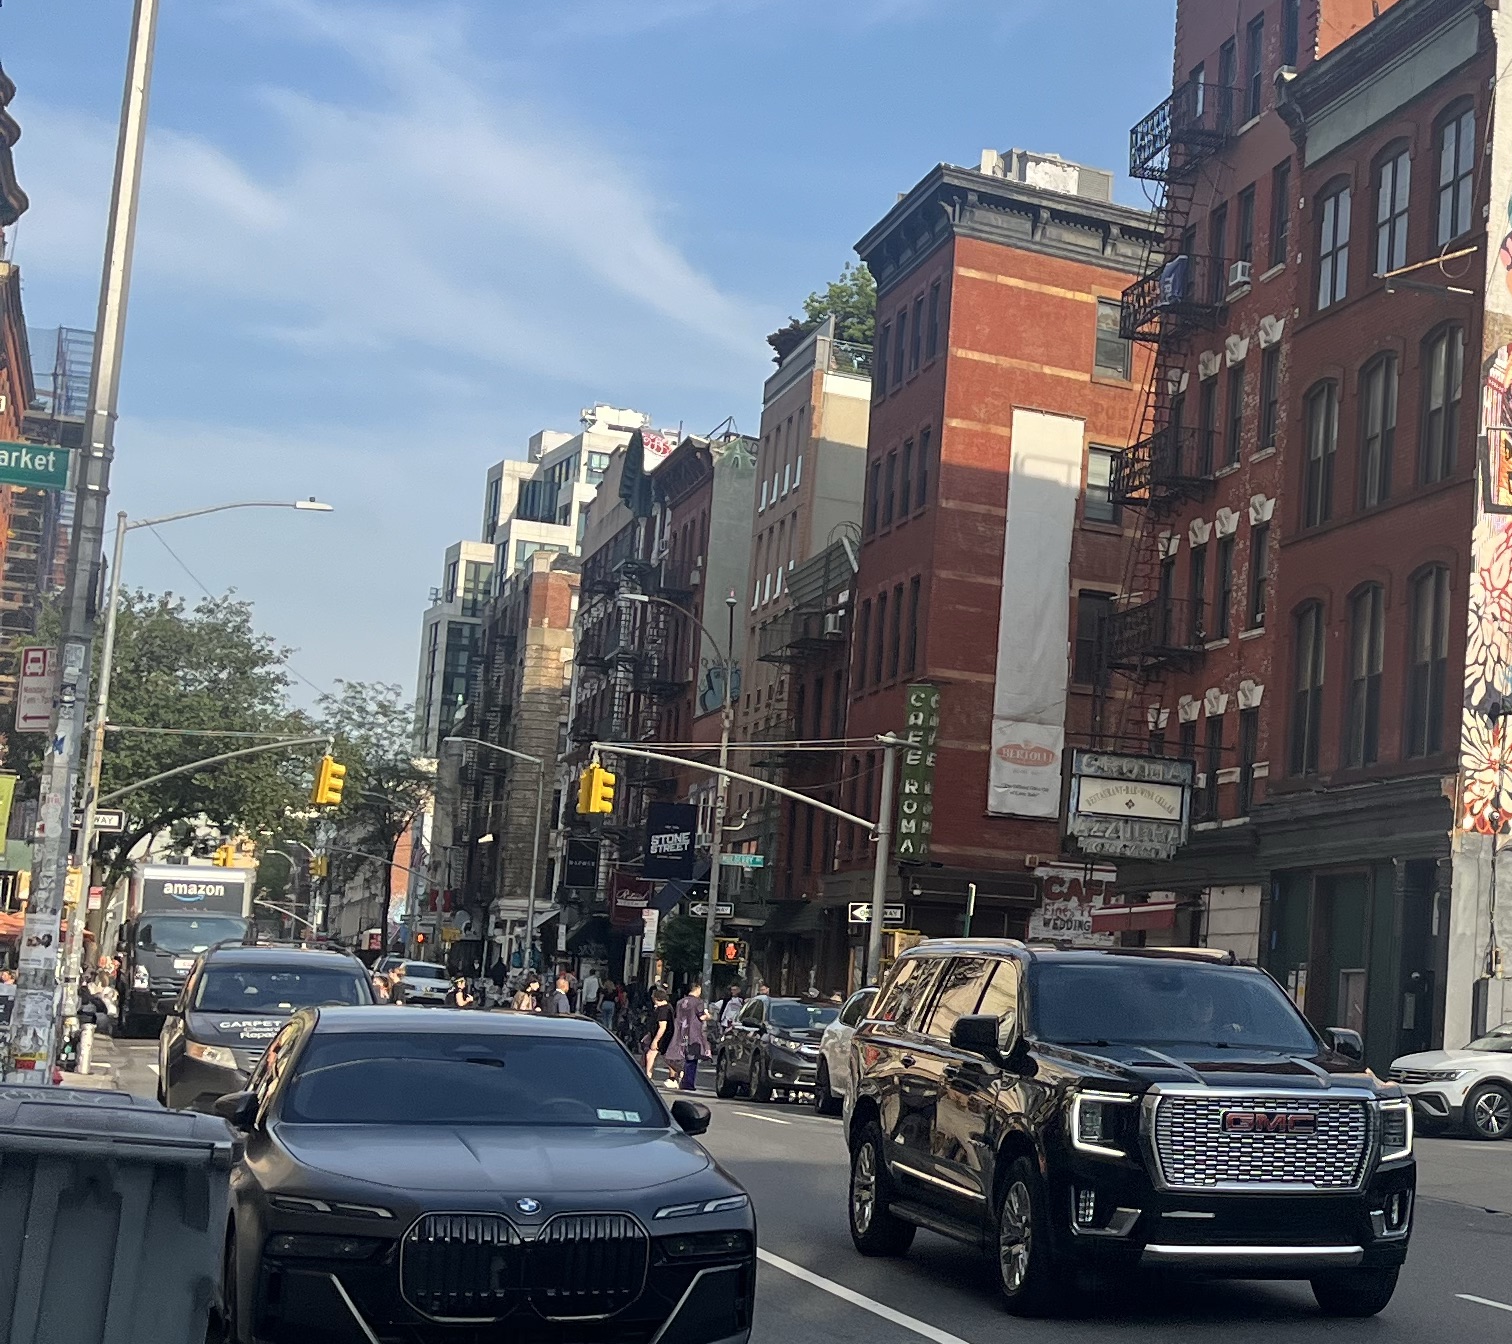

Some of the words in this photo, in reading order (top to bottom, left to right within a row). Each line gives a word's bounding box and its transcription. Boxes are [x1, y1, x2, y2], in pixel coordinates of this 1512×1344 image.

[900, 778, 919, 855] ROMA
[651, 832, 691, 845] STONE
[650, 842, 689, 854] STREET
[163, 882, 225, 897] amazon
[1043, 916, 1091, 931] WEDDING
[219, 1019, 282, 1029] CARPET
[1225, 1112, 1315, 1133] GMC
